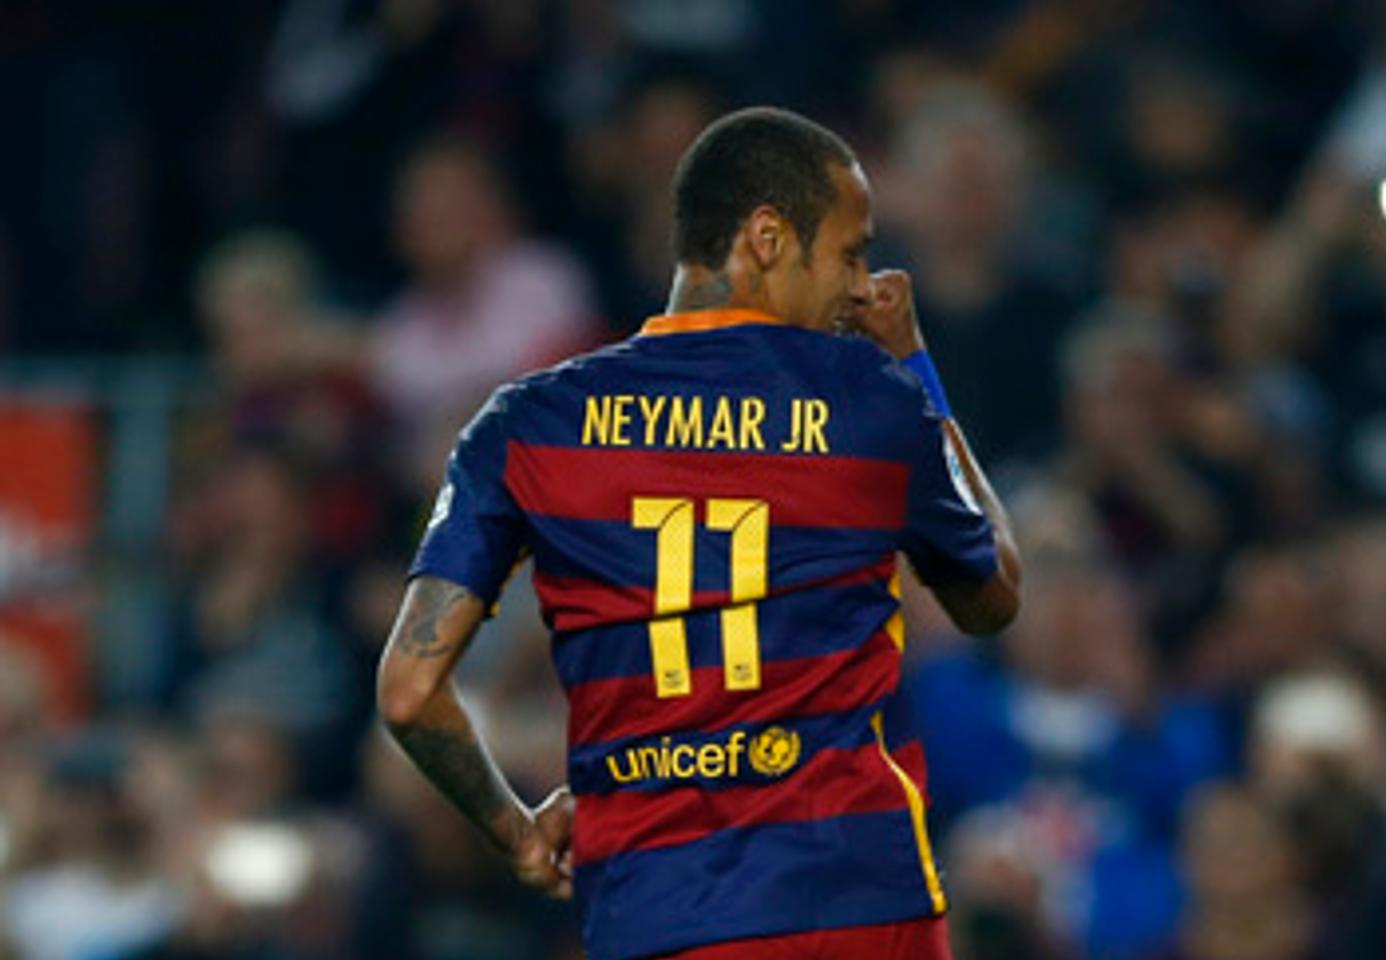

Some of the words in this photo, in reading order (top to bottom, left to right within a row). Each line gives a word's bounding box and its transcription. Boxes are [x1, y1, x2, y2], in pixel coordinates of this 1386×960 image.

[581, 395, 766, 450] NEYMAR
[781, 398, 829, 453] JR
[631, 497, 769, 697] 11
[606, 730, 746, 781] unicef
